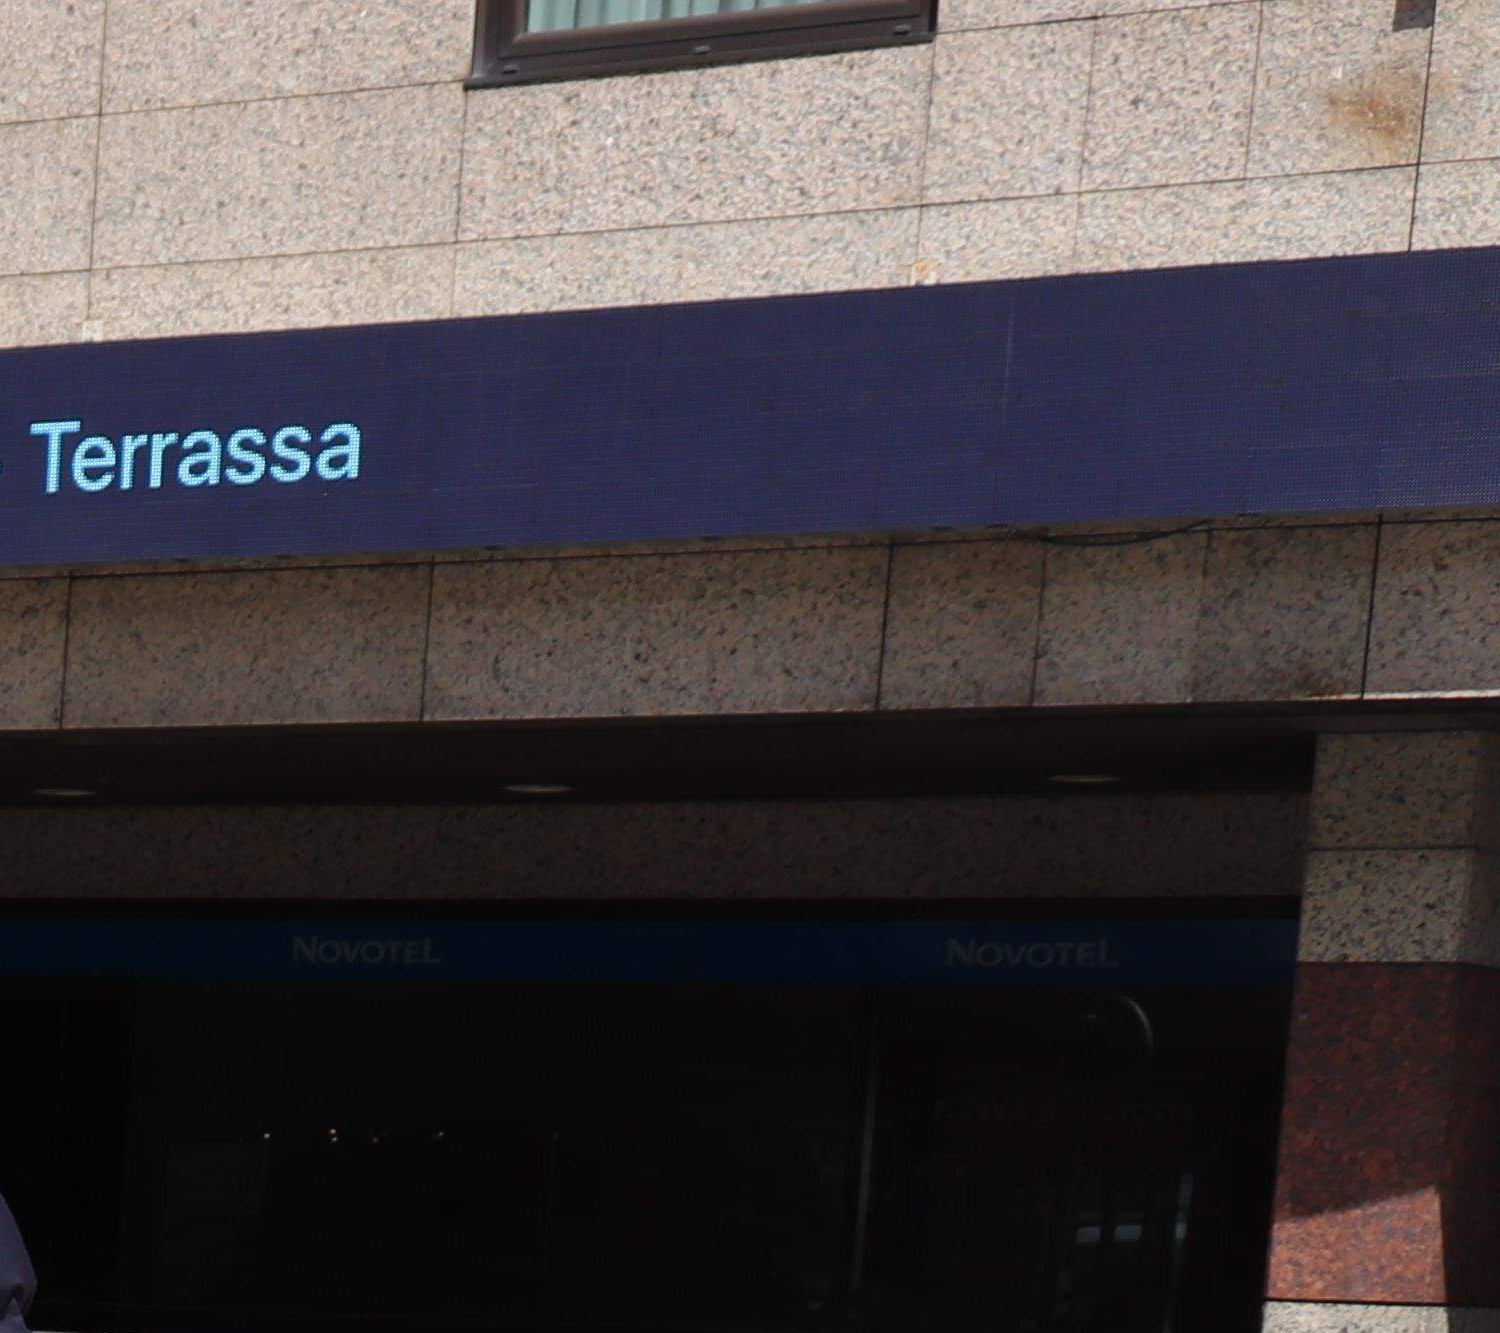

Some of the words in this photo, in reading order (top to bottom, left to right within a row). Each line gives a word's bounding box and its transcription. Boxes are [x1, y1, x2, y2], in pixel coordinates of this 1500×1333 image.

[30, 420, 363, 495] Terrassa
[291, 935, 442, 966] NOVOTEL
[945, 937, 1120, 969] NOVOTEL
